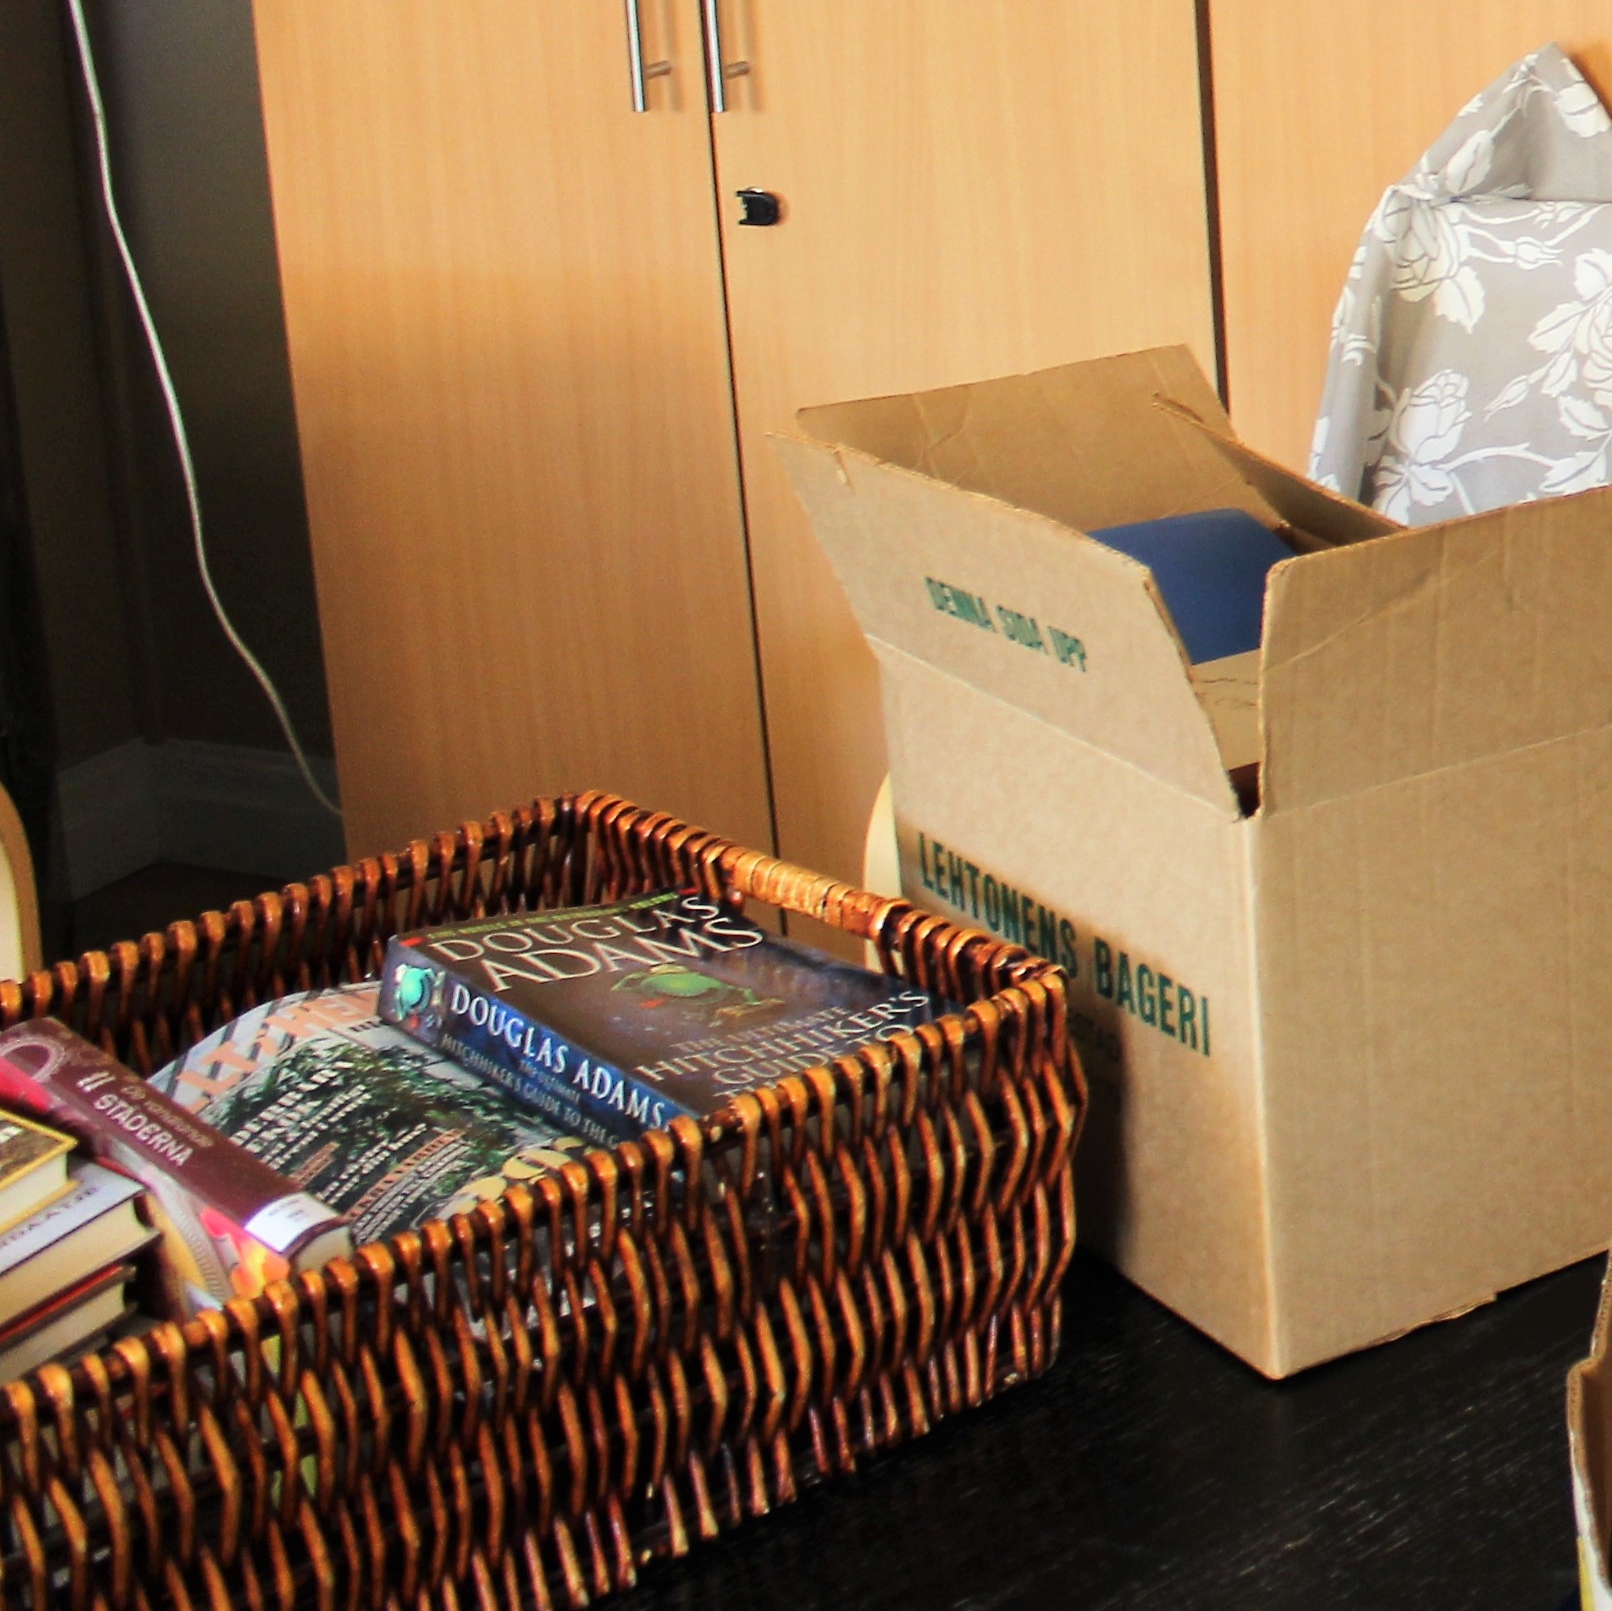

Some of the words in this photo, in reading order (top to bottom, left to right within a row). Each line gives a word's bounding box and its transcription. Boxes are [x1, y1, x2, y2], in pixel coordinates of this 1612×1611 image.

[925, 576, 998, 633] DENNA
[996, 604, 1049, 656] SIDA
[1048, 625, 1087, 672] UPP
[428, 896, 719, 962] DOUGLAS
[481, 917, 763, 992] ADAMS
[919, 832, 1078, 979] LEHTONENS
[1094, 936, 1210, 1057] BAGERI
[451, 983, 569, 1073] DOUGLAS
[573, 1059, 666, 1129] ADAMS
[635, 990, 929, 1081] HITCHHIKER'S
[712, 1047, 848, 1086] GUIDE
